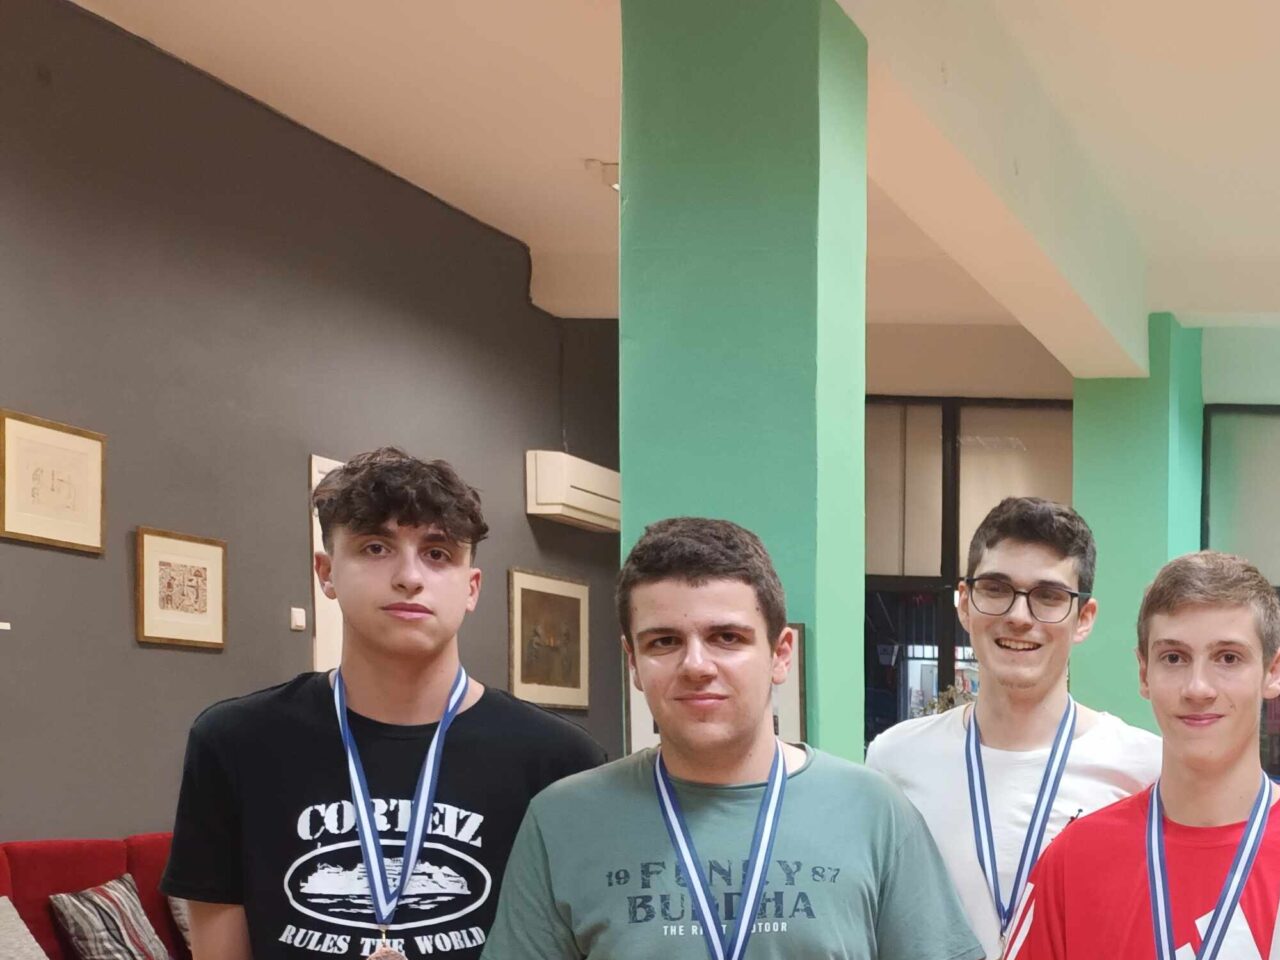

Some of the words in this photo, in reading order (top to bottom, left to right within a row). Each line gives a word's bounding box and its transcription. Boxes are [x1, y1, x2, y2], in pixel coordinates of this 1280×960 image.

[606, 869, 630, 887] 19
[811, 866, 840, 884] 87
[278, 924, 350, 954] RULES
[360, 937, 405, 957] THE
[414, 926, 486, 955] WORLD
[663, 925, 685, 936] THE
